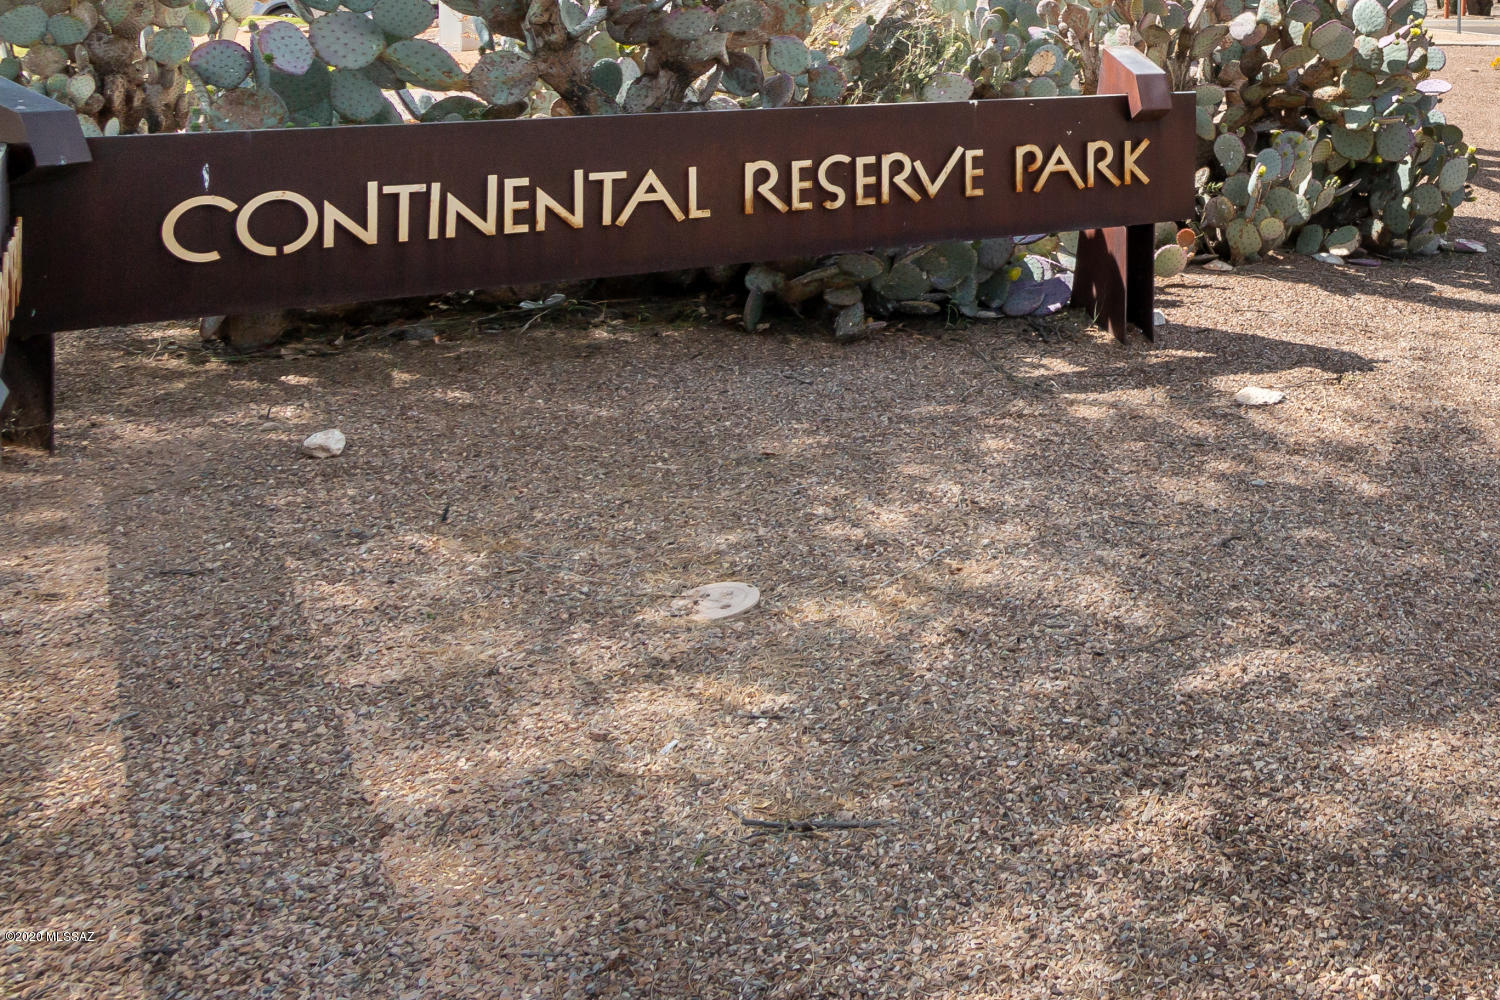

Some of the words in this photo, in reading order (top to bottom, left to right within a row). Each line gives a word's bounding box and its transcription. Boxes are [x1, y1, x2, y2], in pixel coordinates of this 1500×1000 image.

[161, 166, 711, 263] CONTINENTAL
[744, 146, 985, 215] RESERVE
[1015, 137, 1151, 194] PARK
